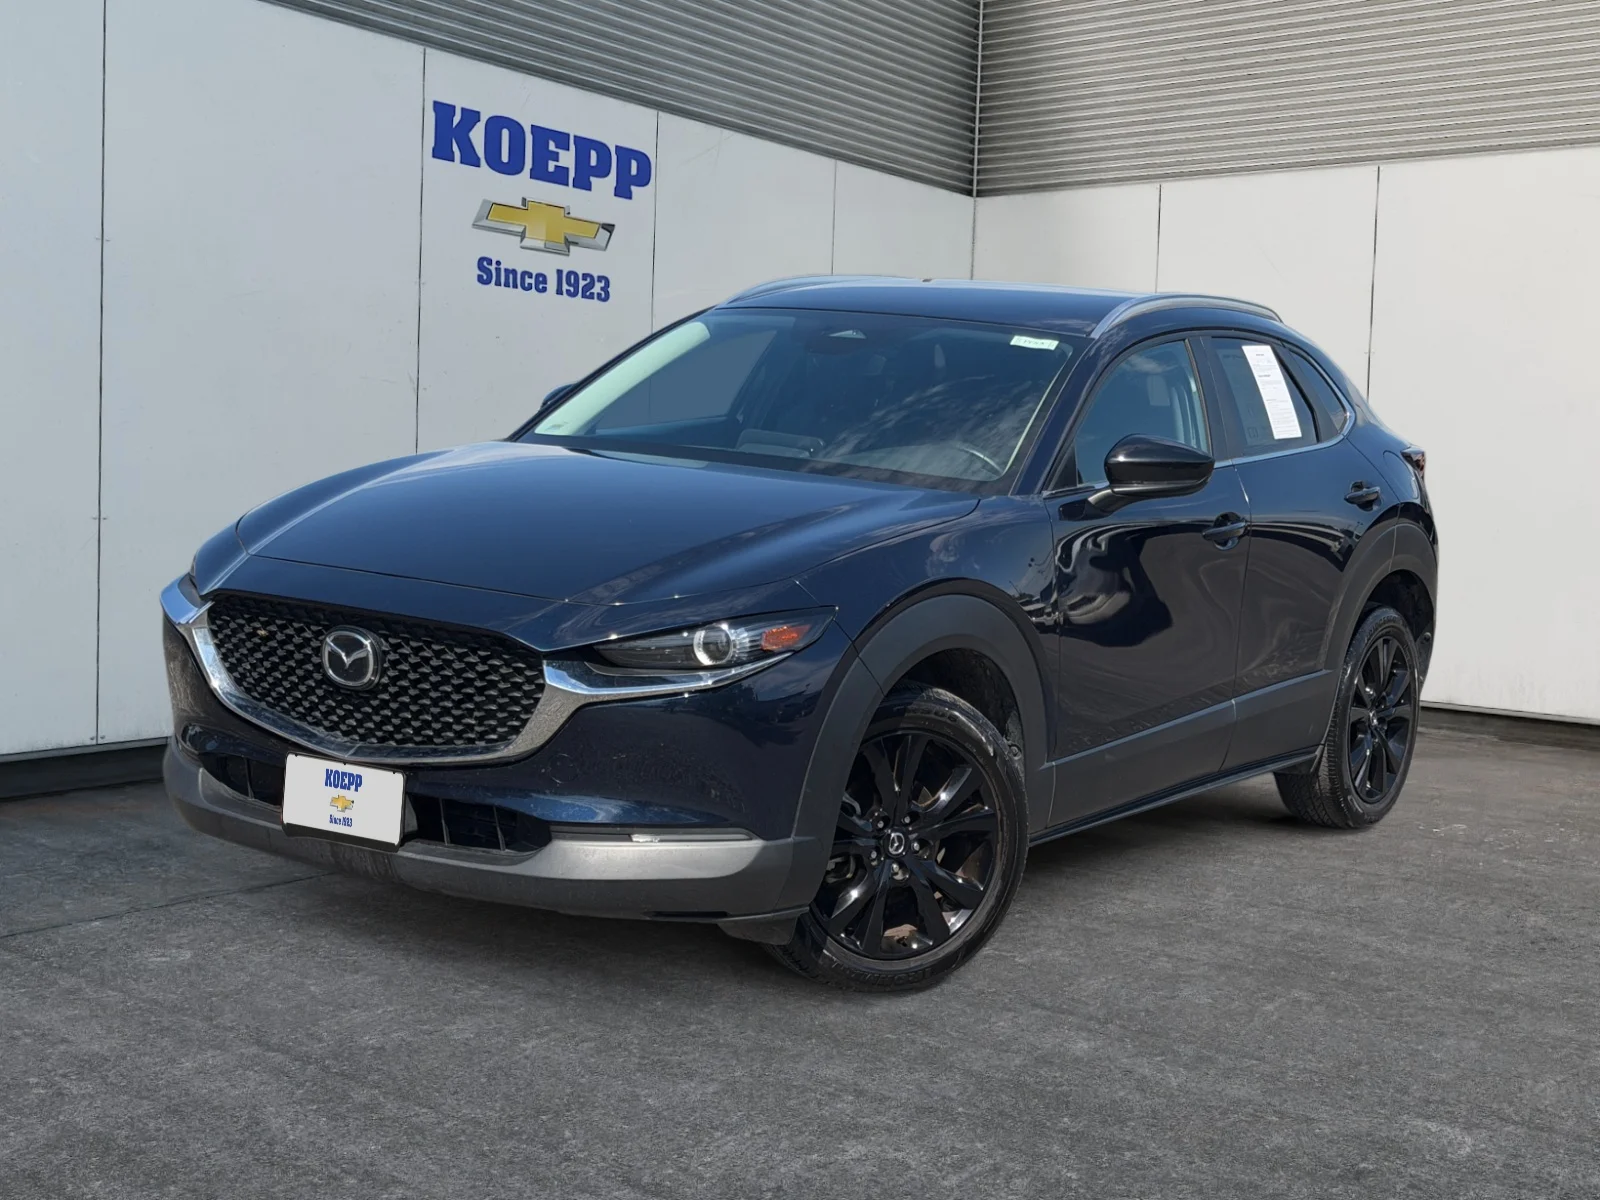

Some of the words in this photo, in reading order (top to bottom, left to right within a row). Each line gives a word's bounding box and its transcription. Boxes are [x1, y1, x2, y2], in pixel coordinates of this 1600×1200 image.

[432, 100, 652, 200] KOEPP
[476, 256, 548, 293] Since
[555, 269, 611, 303] 1923
[324, 768, 363, 792] KOEPP
